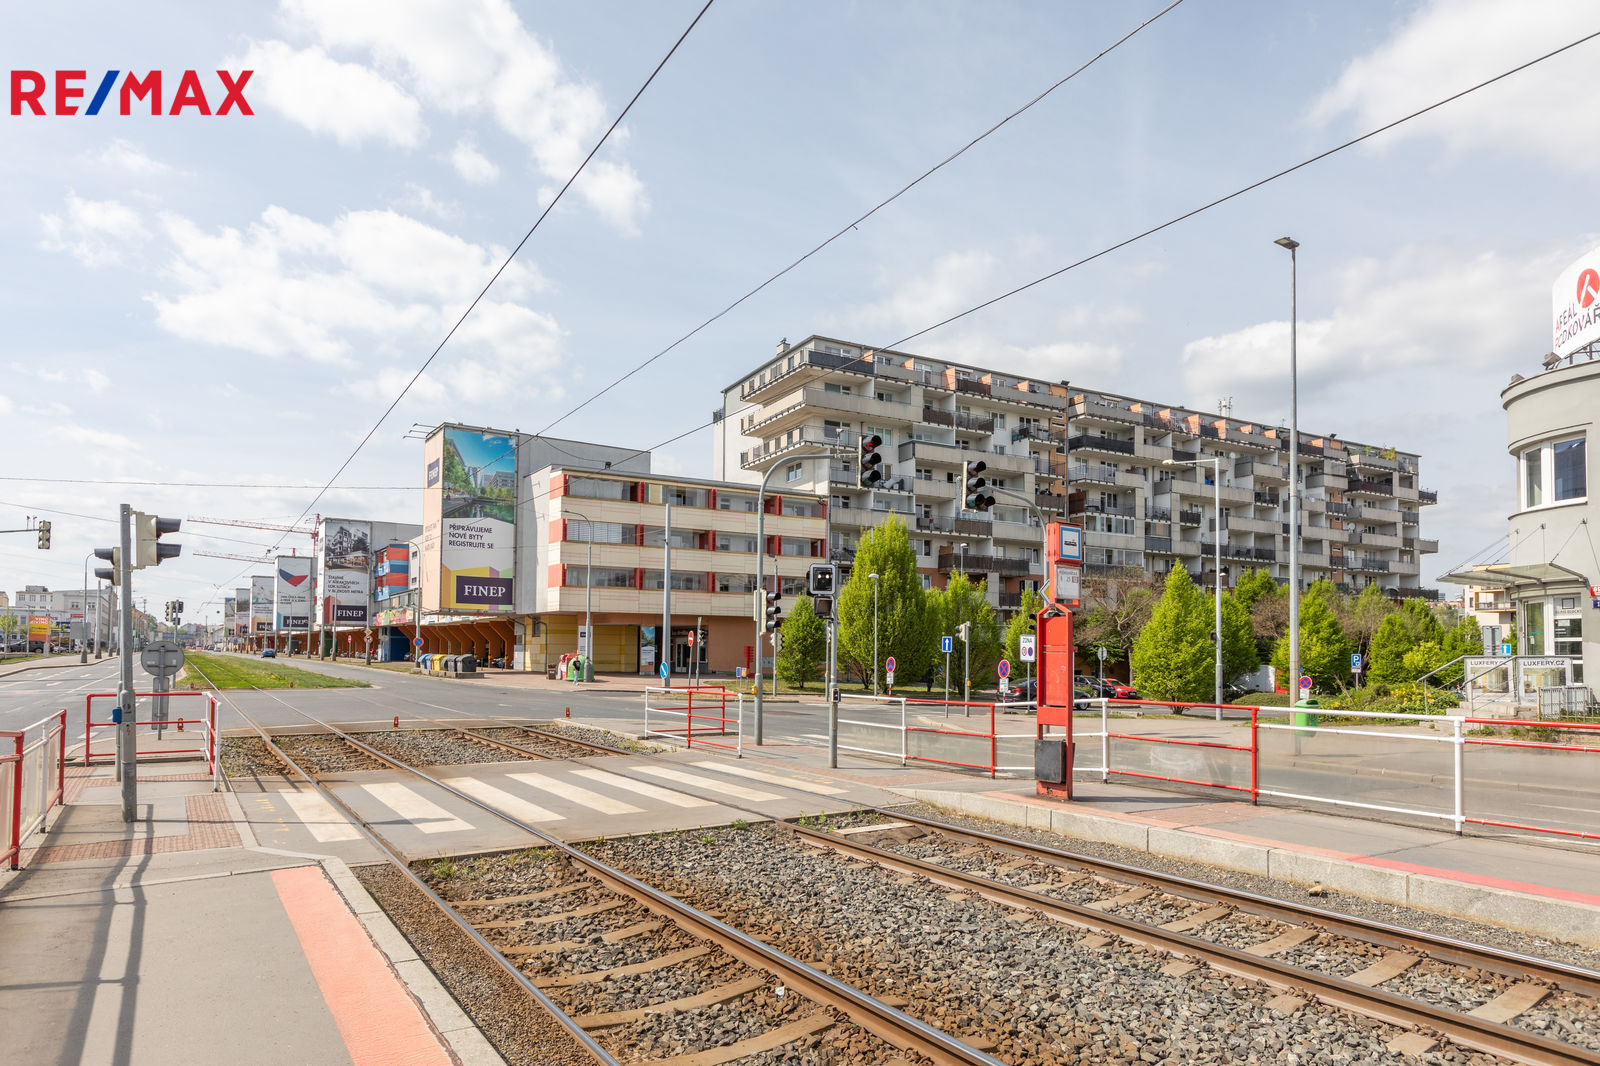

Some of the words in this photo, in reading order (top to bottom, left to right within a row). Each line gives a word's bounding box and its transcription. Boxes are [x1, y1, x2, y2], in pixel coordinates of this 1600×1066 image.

[448, 523, 493, 534] PŘIPRAVUJEME
[448, 532, 467, 540] NOVÉ
[469, 533, 484, 541] BYTY
[448, 540, 486, 549] REGISTRUJTE
[487, 542, 494, 550] SE
[463, 584, 506, 597] FINEP
[337, 609, 364, 617] FINEP
